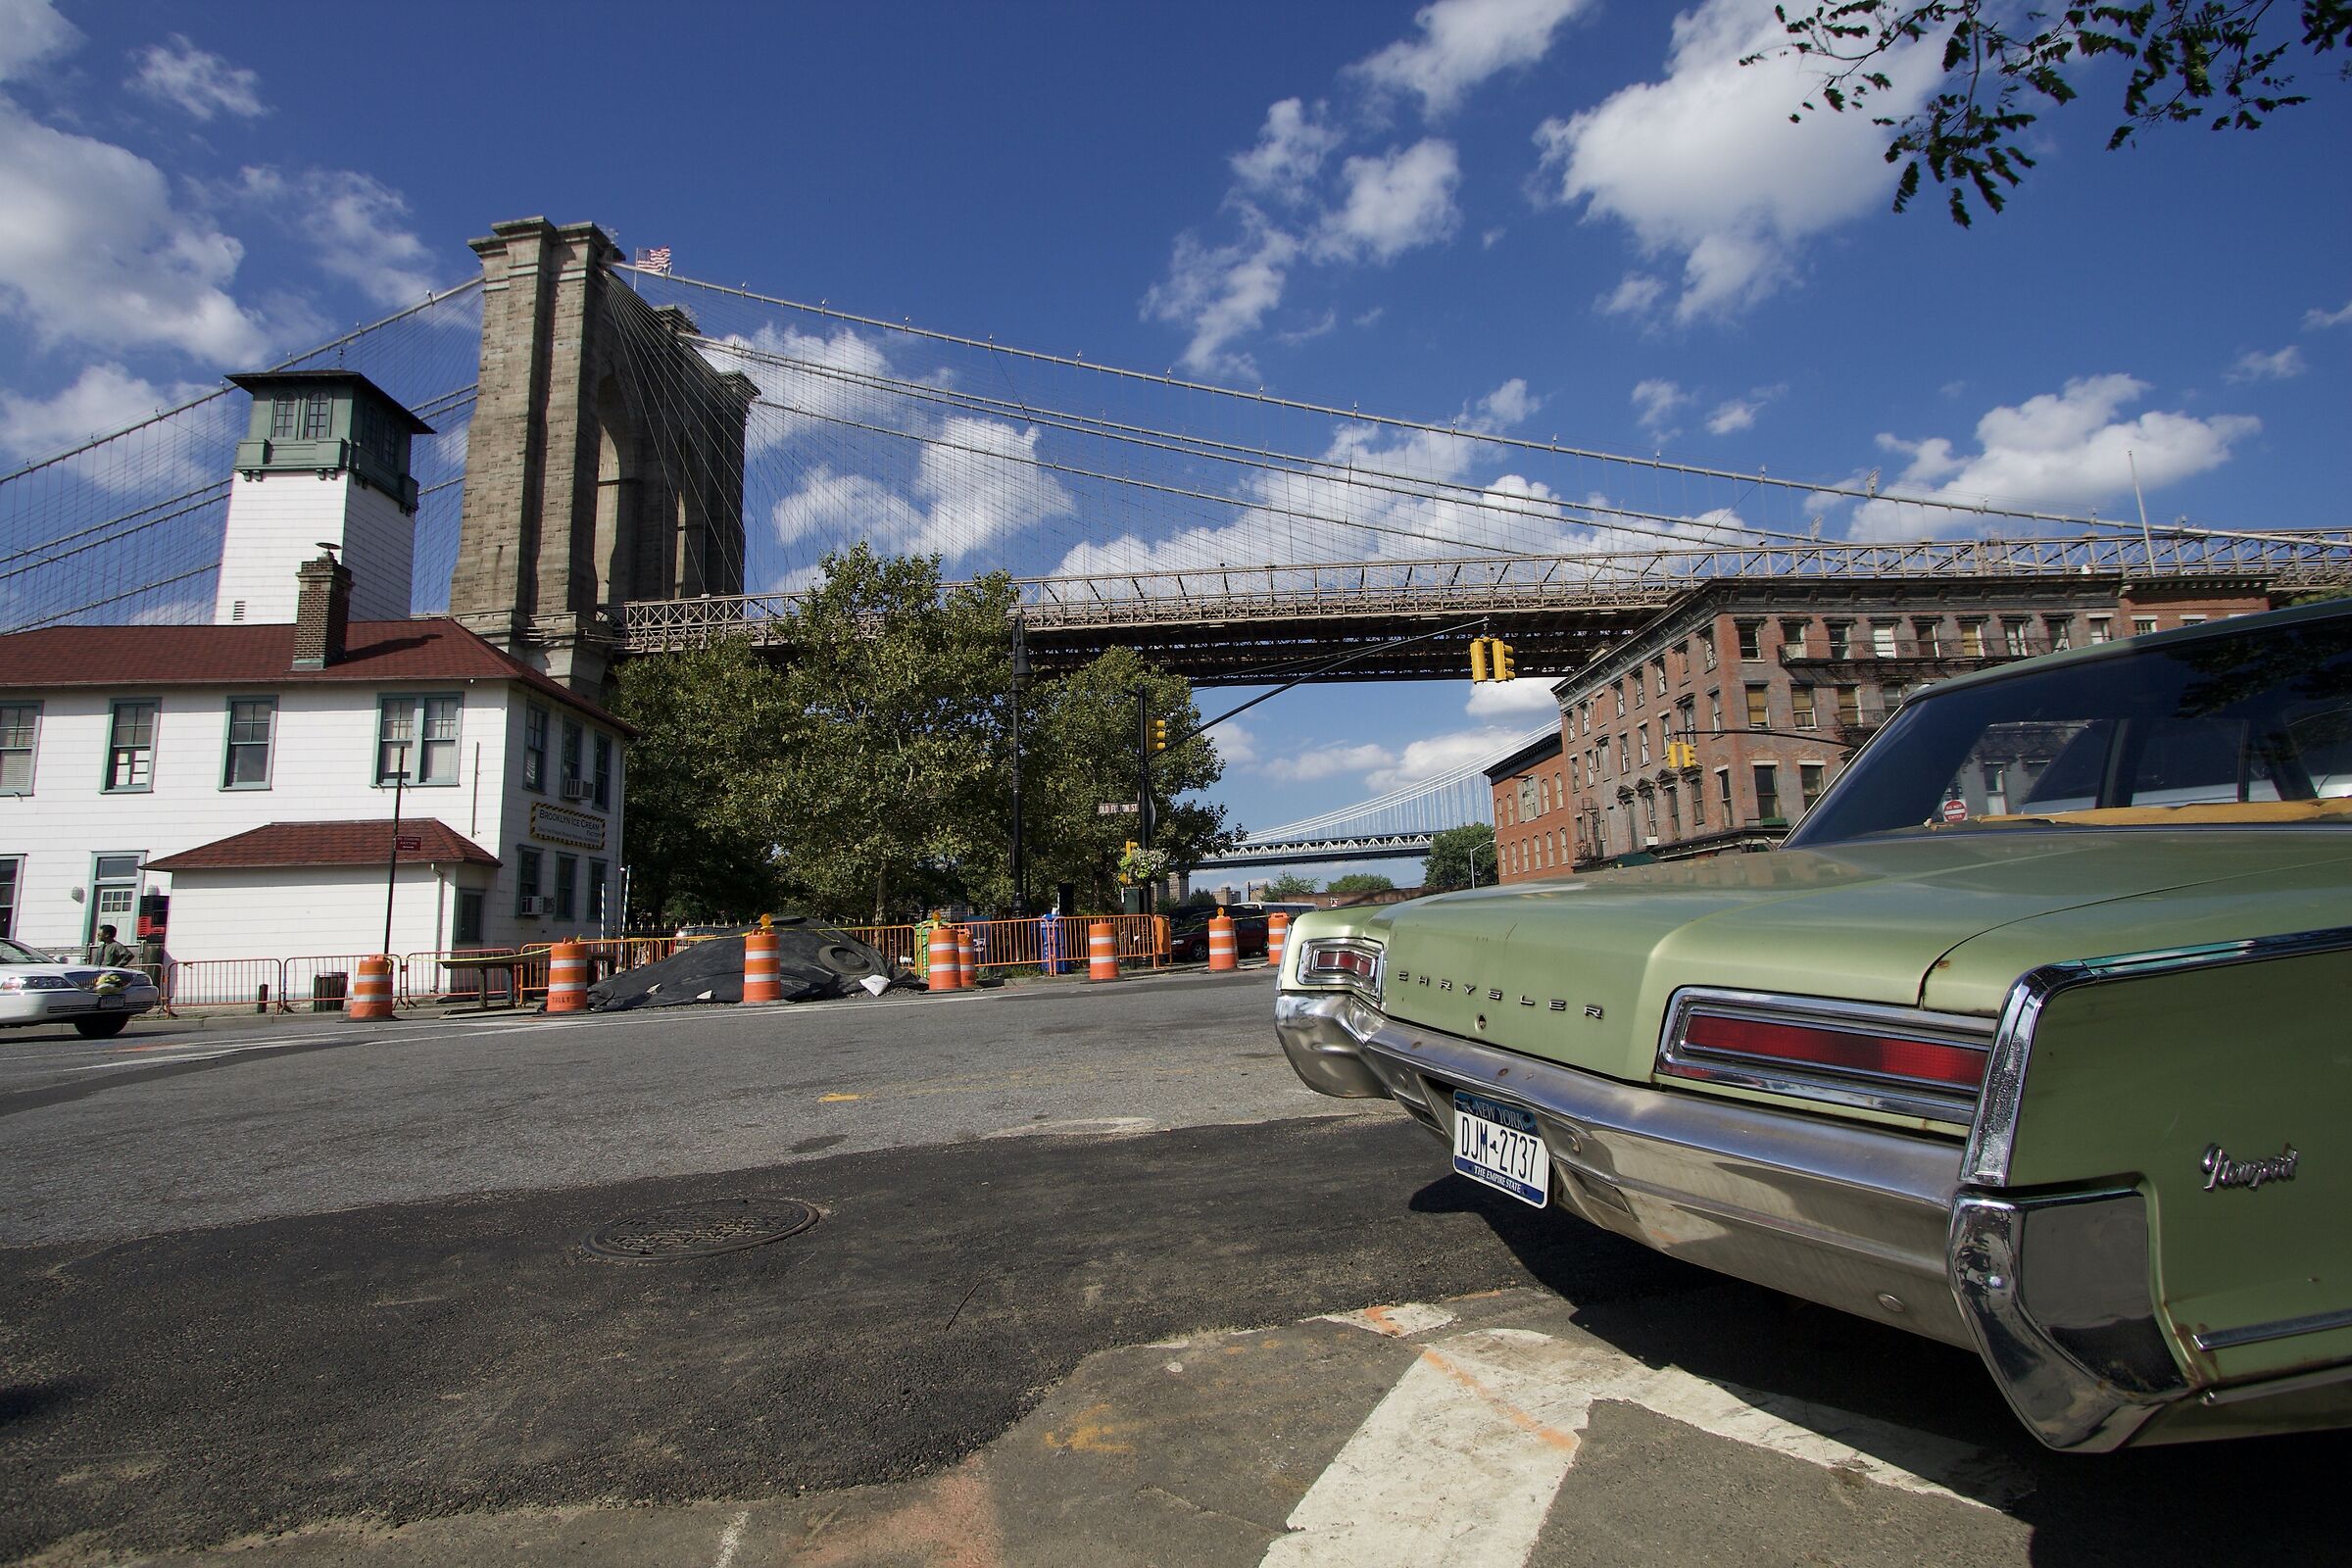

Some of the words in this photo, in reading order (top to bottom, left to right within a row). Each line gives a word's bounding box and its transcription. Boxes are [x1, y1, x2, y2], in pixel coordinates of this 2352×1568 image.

[539, 809, 570, 824] BROOKLYN
[1099, 805, 1109, 813] OLD
[1398, 971, 1603, 1019] CHRYSLER
[1475, 1100, 1495, 1121] NEW
[1496, 1106, 1525, 1131] YORK
[1474, 1164, 1486, 1177] THE
[1486, 1170, 1506, 1187] EMPIRE
[1506, 1179, 1522, 1193] STATE
[2201, 1144, 2297, 1192] Newport
